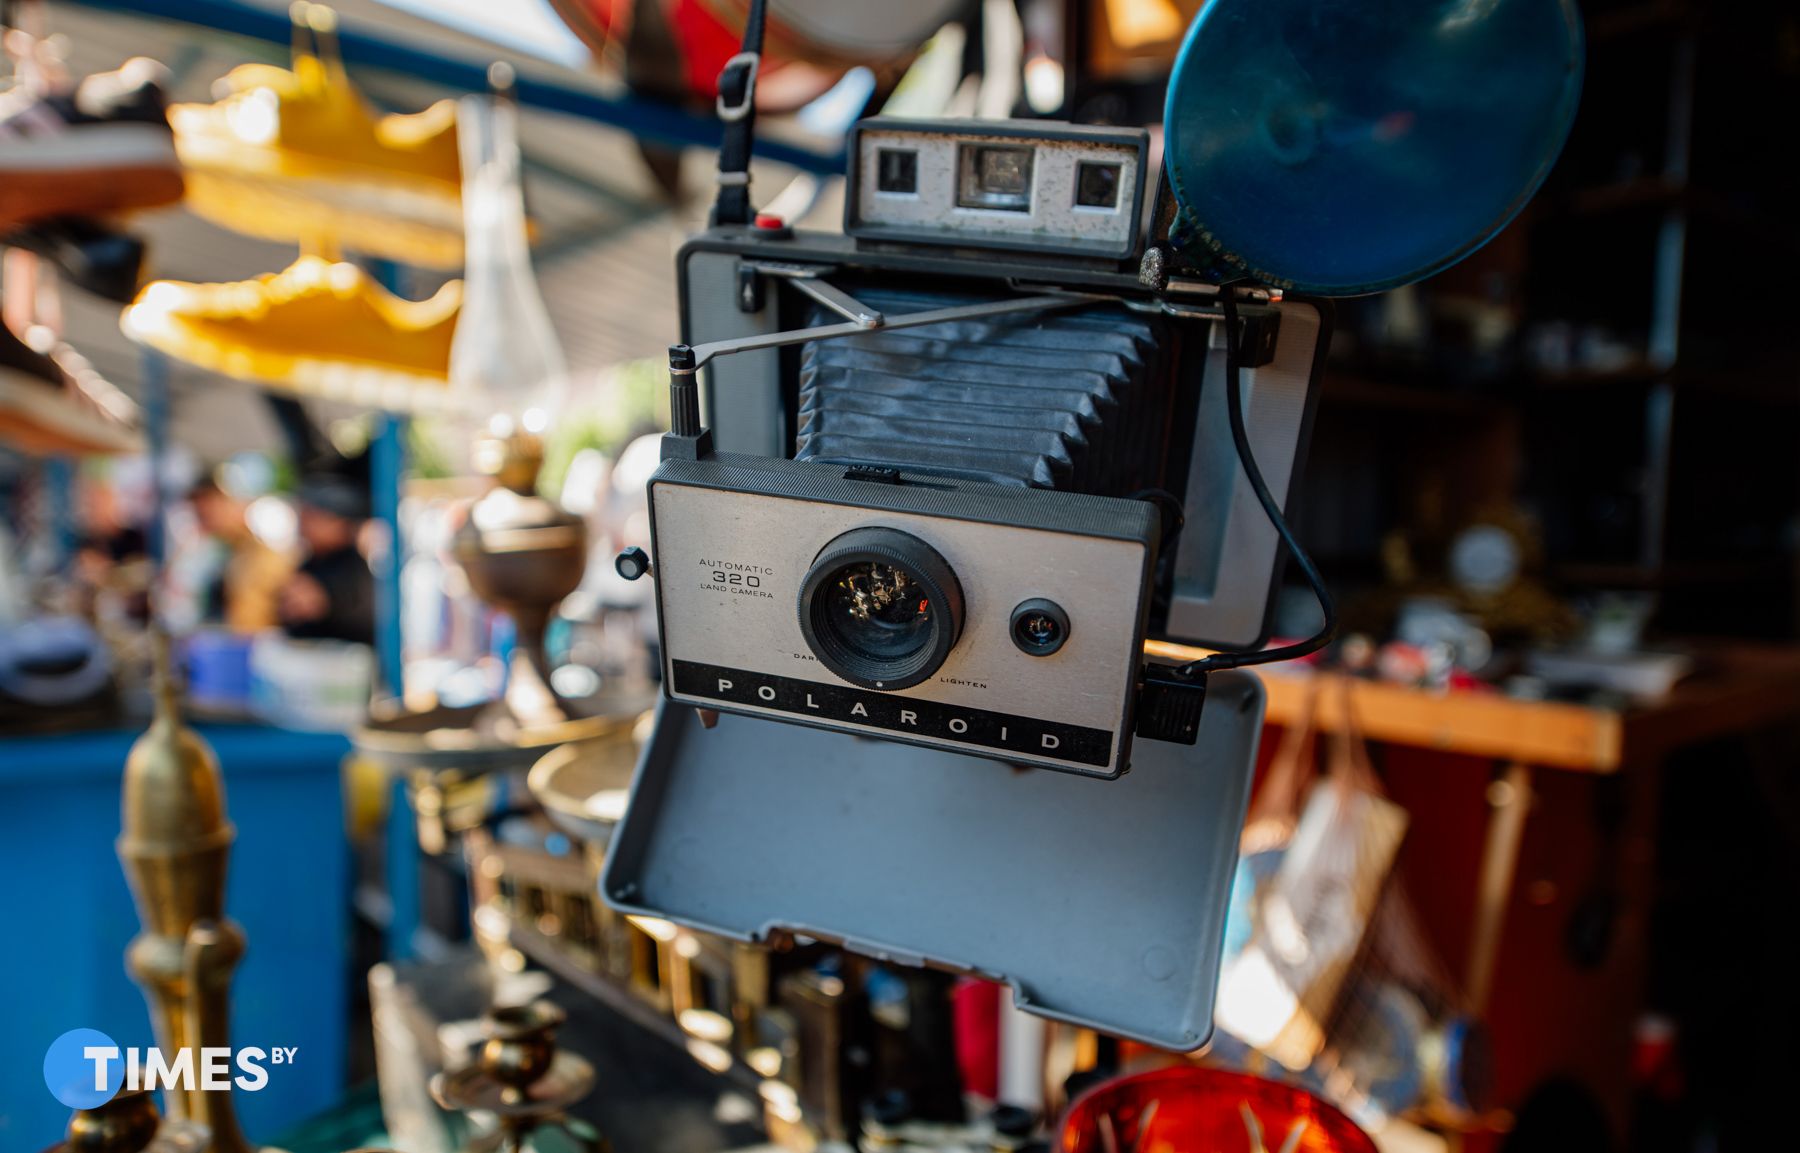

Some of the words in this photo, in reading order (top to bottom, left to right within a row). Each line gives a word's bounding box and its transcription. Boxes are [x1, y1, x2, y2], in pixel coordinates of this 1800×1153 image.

[699, 558, 774, 576] AUTOMATIC
[712, 570, 760, 588] 320
[700, 583, 727, 592] LAND
[730, 587, 774, 599] CAMERA
[793, 653, 819, 661] DAR
[940, 677, 987, 689] LIGHTEN
[717, 677, 1061, 750] POLAROID
